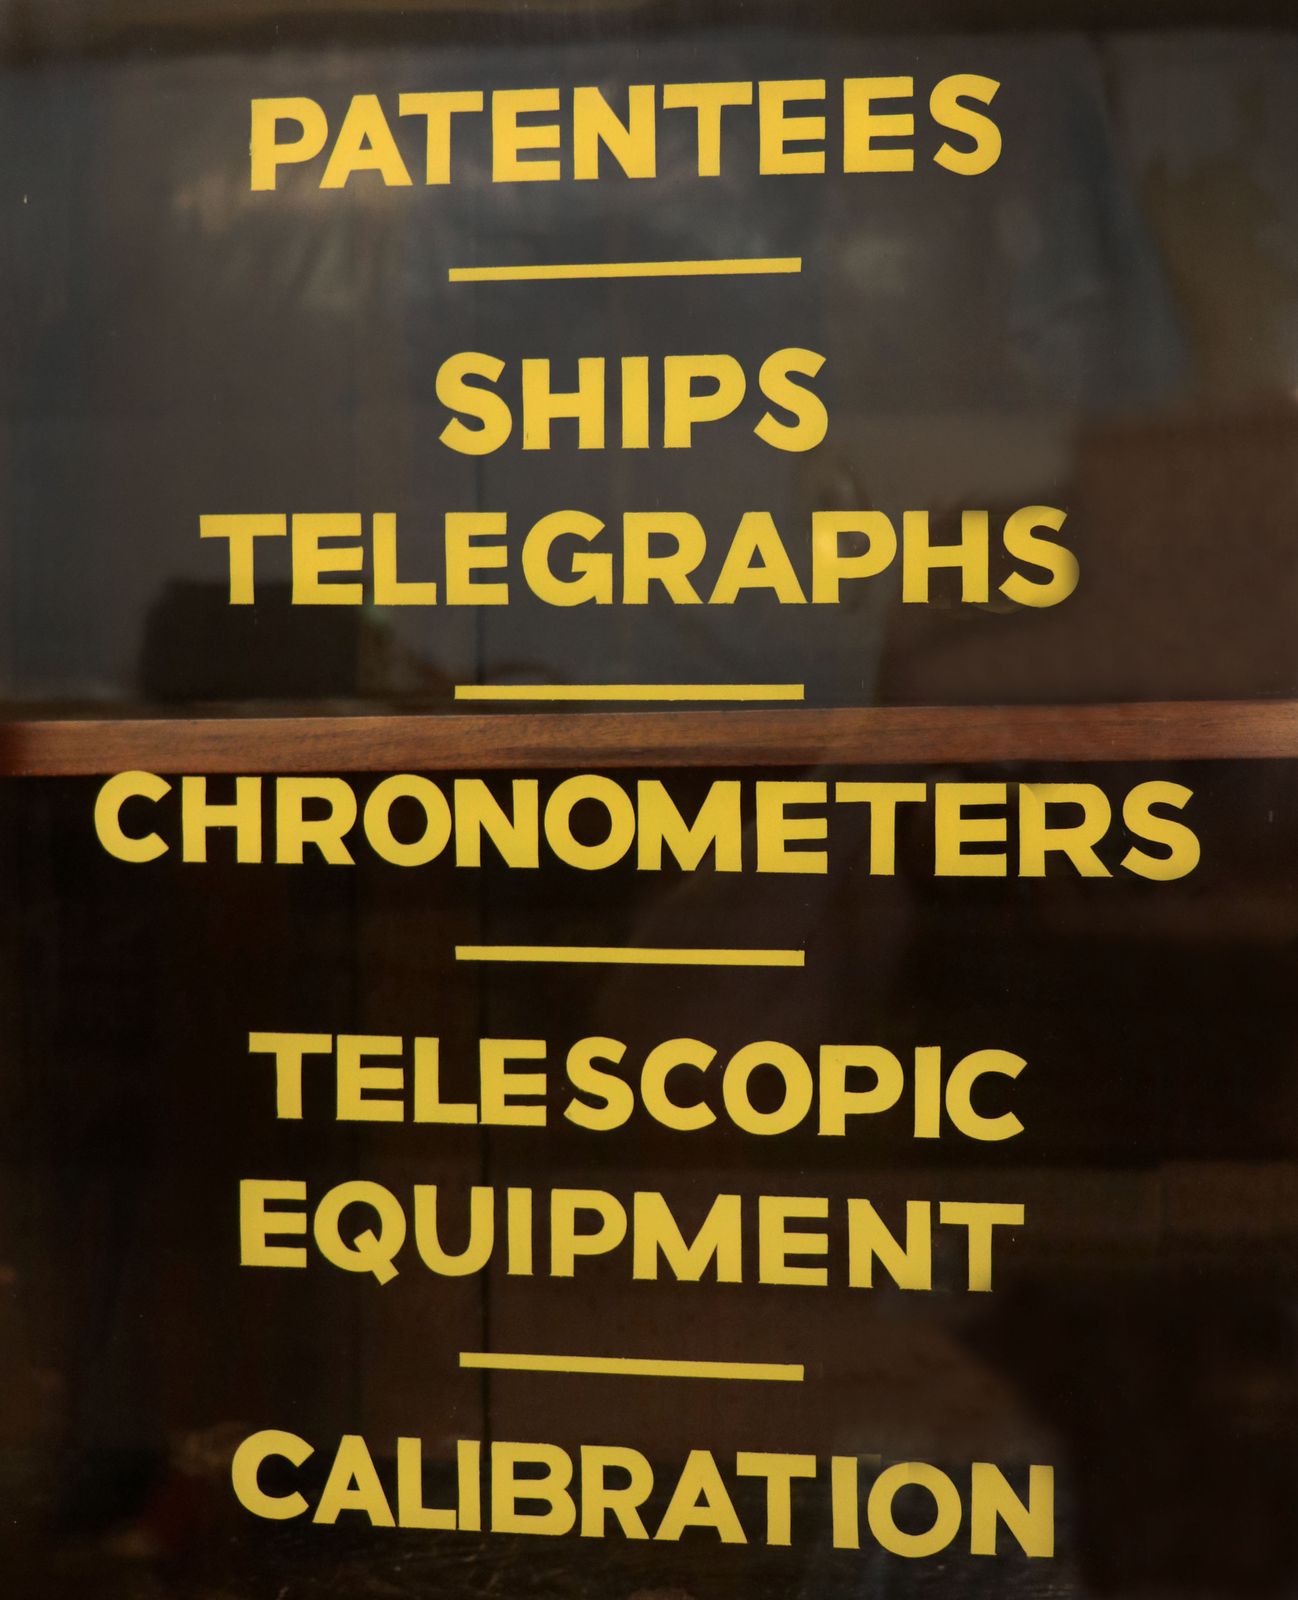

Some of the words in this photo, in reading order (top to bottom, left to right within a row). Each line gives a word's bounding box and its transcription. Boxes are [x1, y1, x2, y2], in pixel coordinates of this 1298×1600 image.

[249, 74, 1002, 192] PATENTEES
[435, 347, 829, 455] SHIPS
[199, 505, 1079, 607] TELEGRAPHS
[94, 771, 1201, 881] CHRONOMETERS
[249, 1032, 1027, 1140] TELESCOPIC
[239, 1179, 1025, 1292] EQUIPMENT
[231, 1430, 1054, 1558] CALIBRATION
